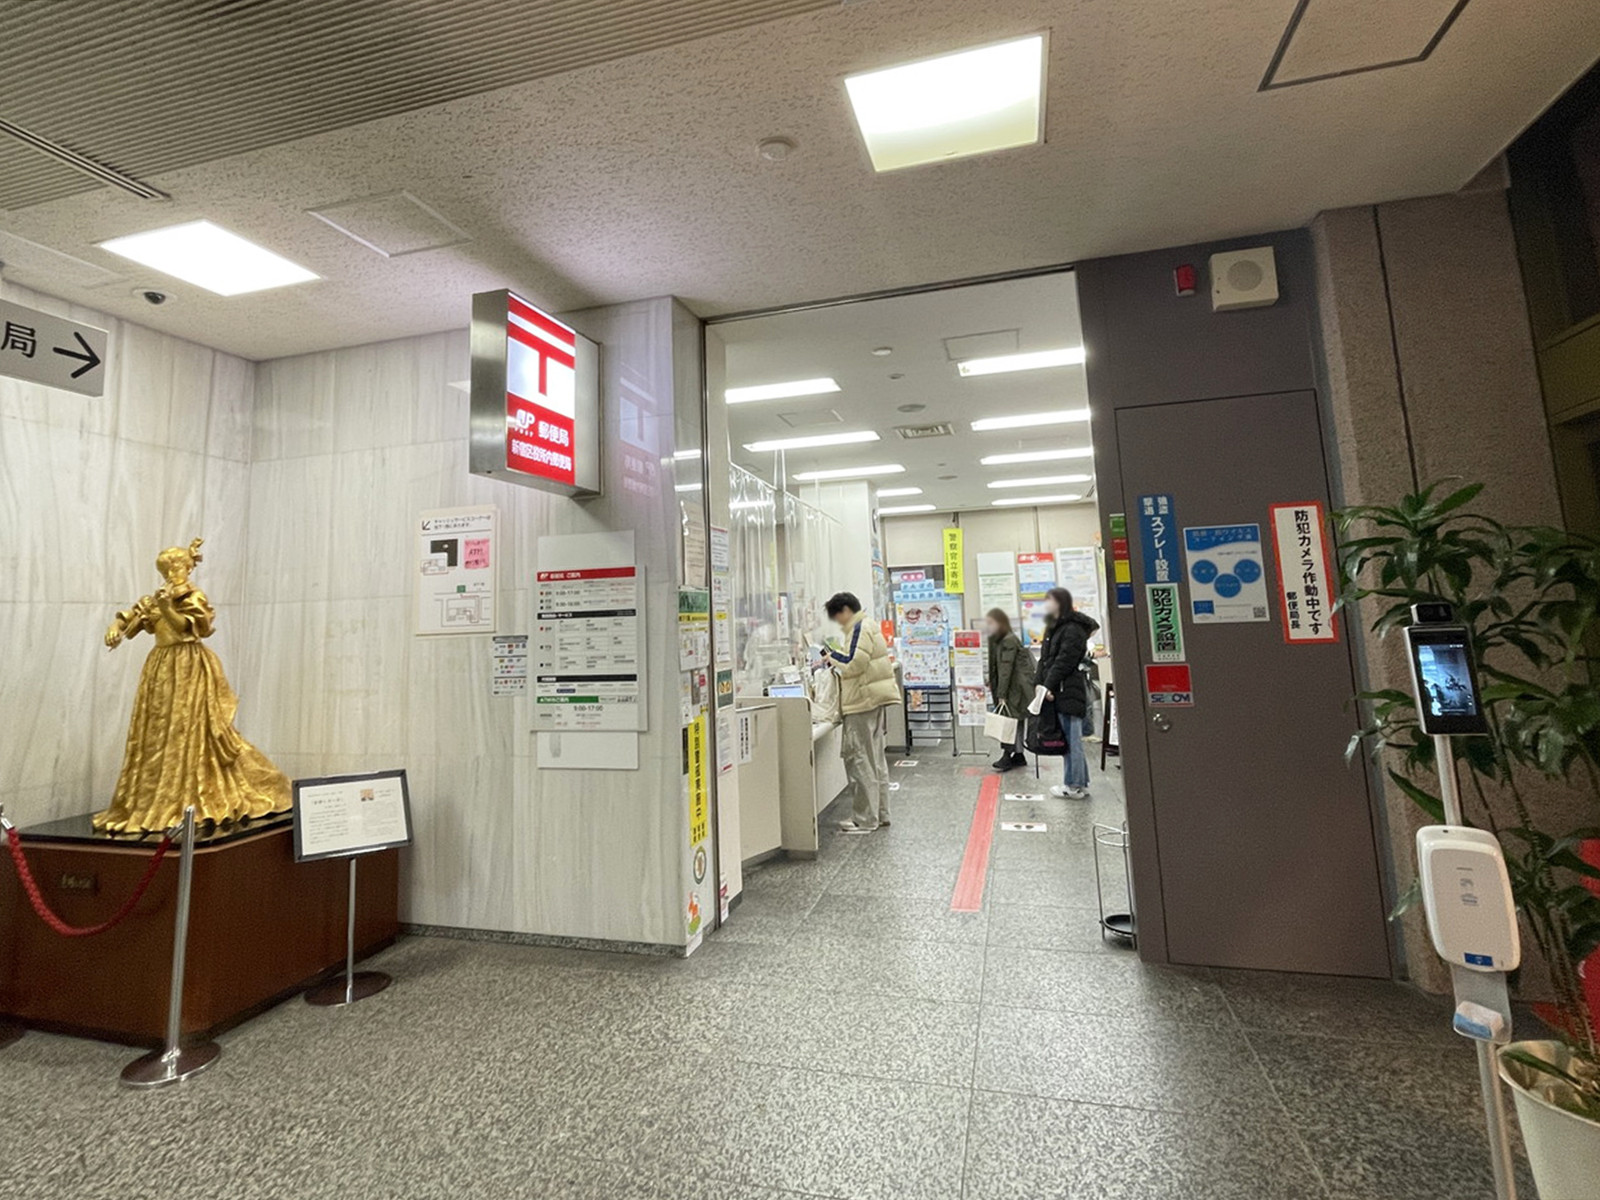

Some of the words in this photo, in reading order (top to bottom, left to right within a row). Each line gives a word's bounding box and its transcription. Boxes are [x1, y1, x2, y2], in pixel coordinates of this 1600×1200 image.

[0, 321, 37, 358] 局
[538, 421, 569, 447] 郵便局
[1151, 516, 1170, 582] スプレー設置
[1294, 510, 1322, 635] 防犯カメラ作動中です
[1152, 588, 1177, 652] 防犯カメラ設置
[1286, 591, 1301, 629] 郵便局長
